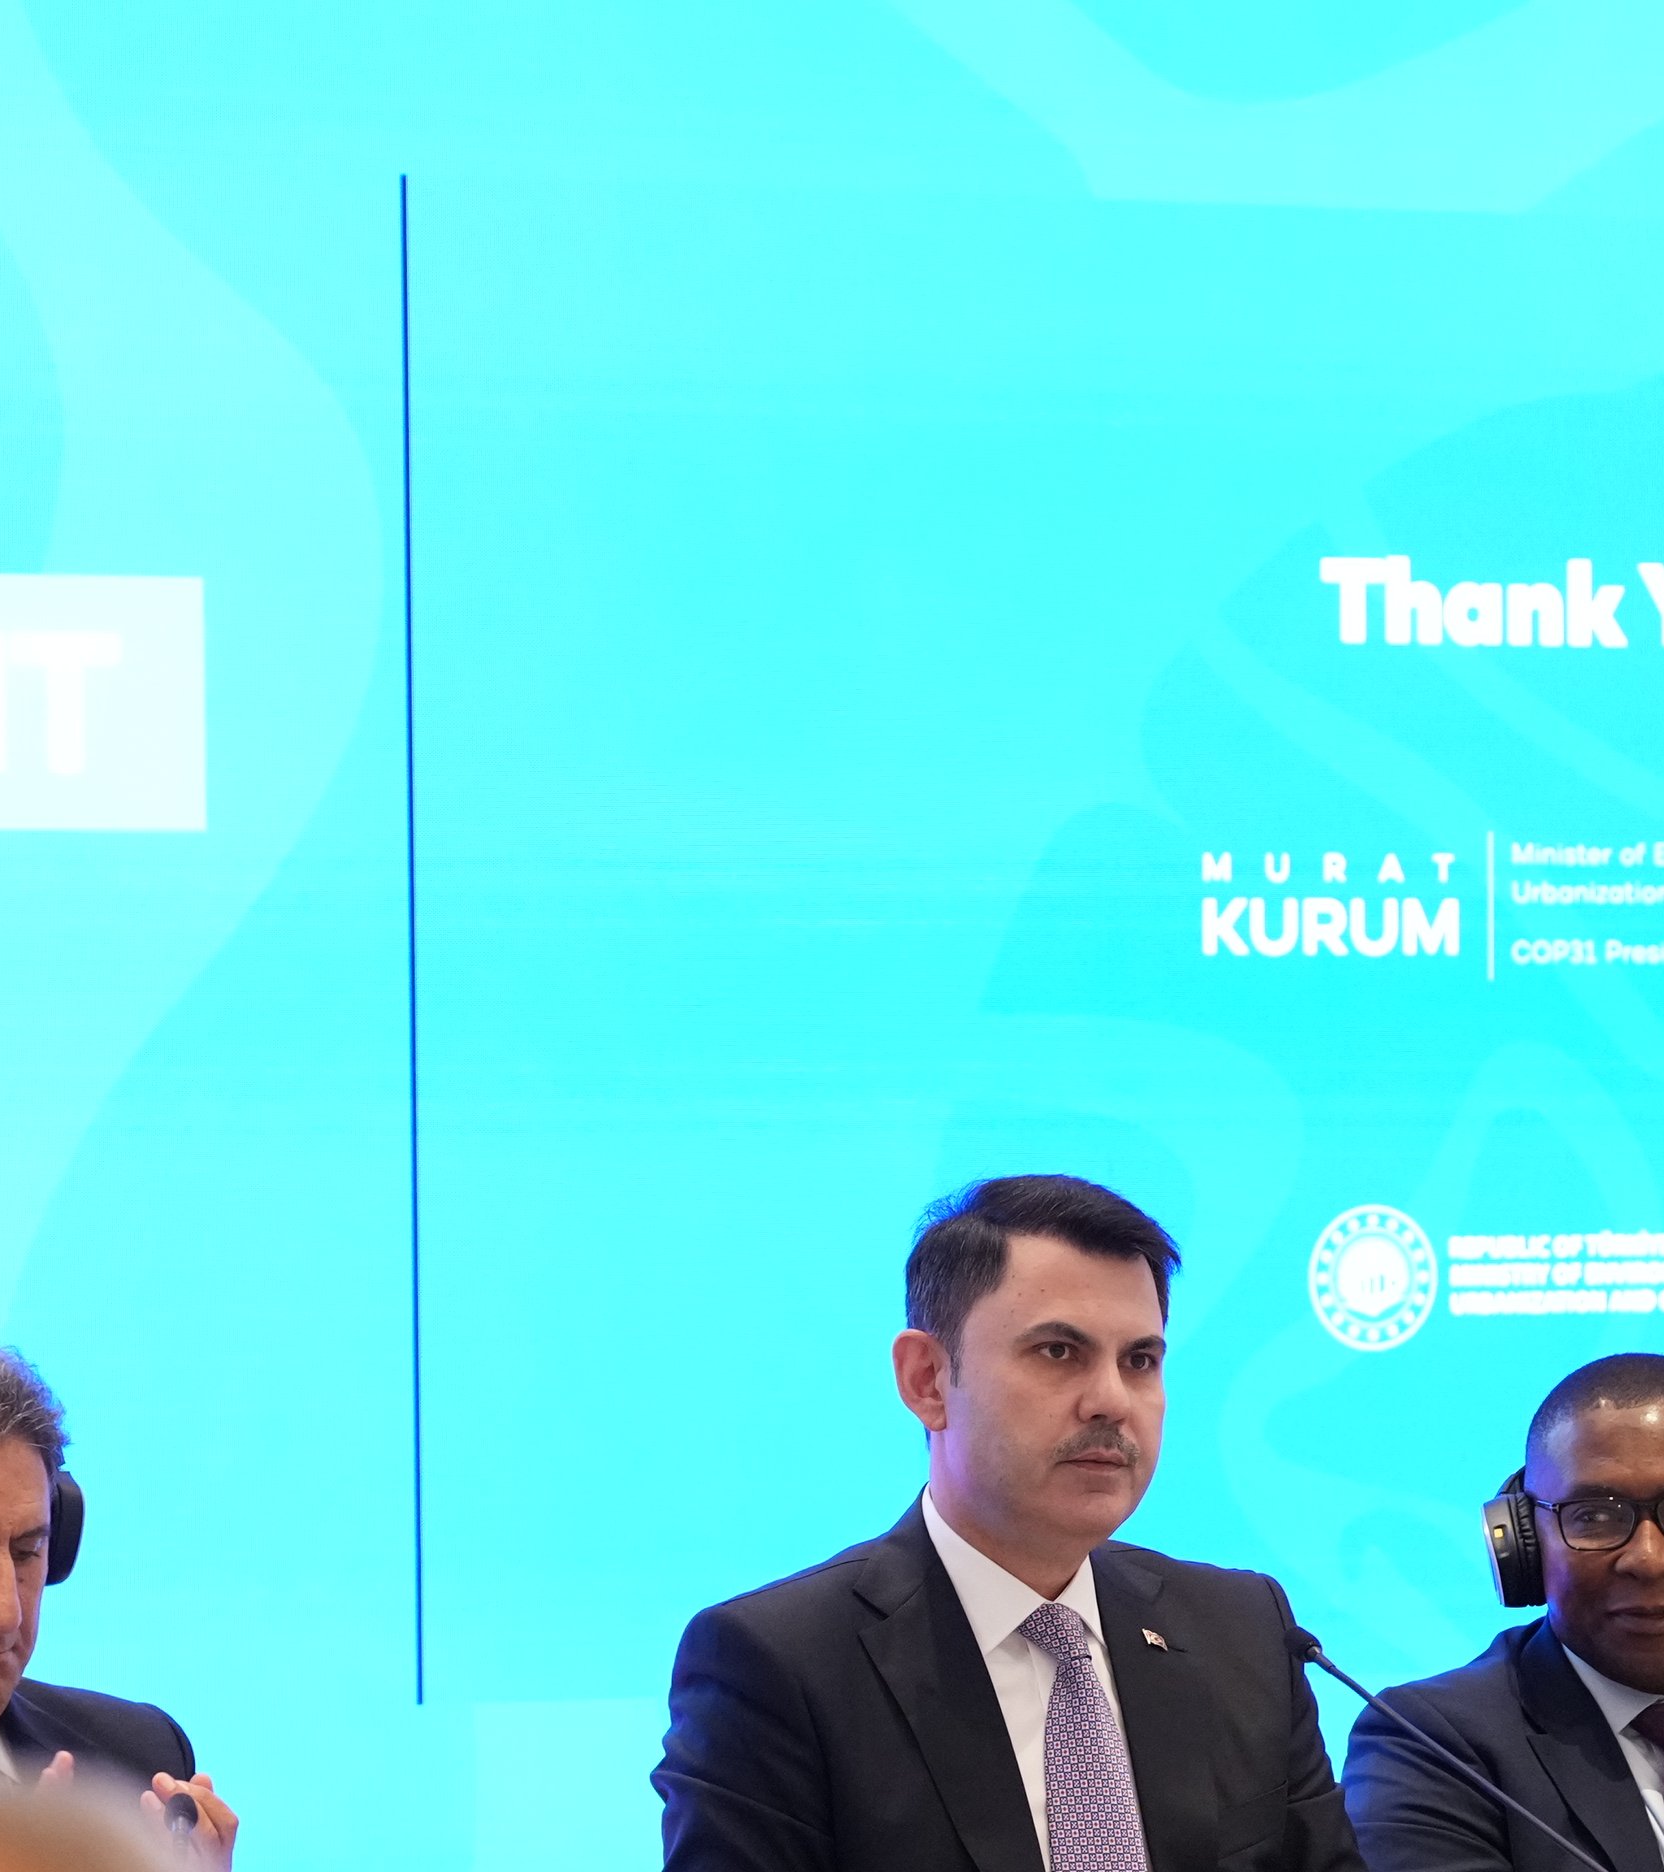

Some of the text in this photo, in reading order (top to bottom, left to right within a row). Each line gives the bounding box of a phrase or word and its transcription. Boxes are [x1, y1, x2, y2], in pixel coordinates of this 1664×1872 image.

[1320, 555, 1628, 648] Thank
[1201, 851, 1455, 883] MURAT
[1511, 841, 1613, 866] Minister
[1619, 842, 1647, 867] of
[1201, 897, 1460, 957] KURUM
[1511, 939, 1598, 965] COP31
